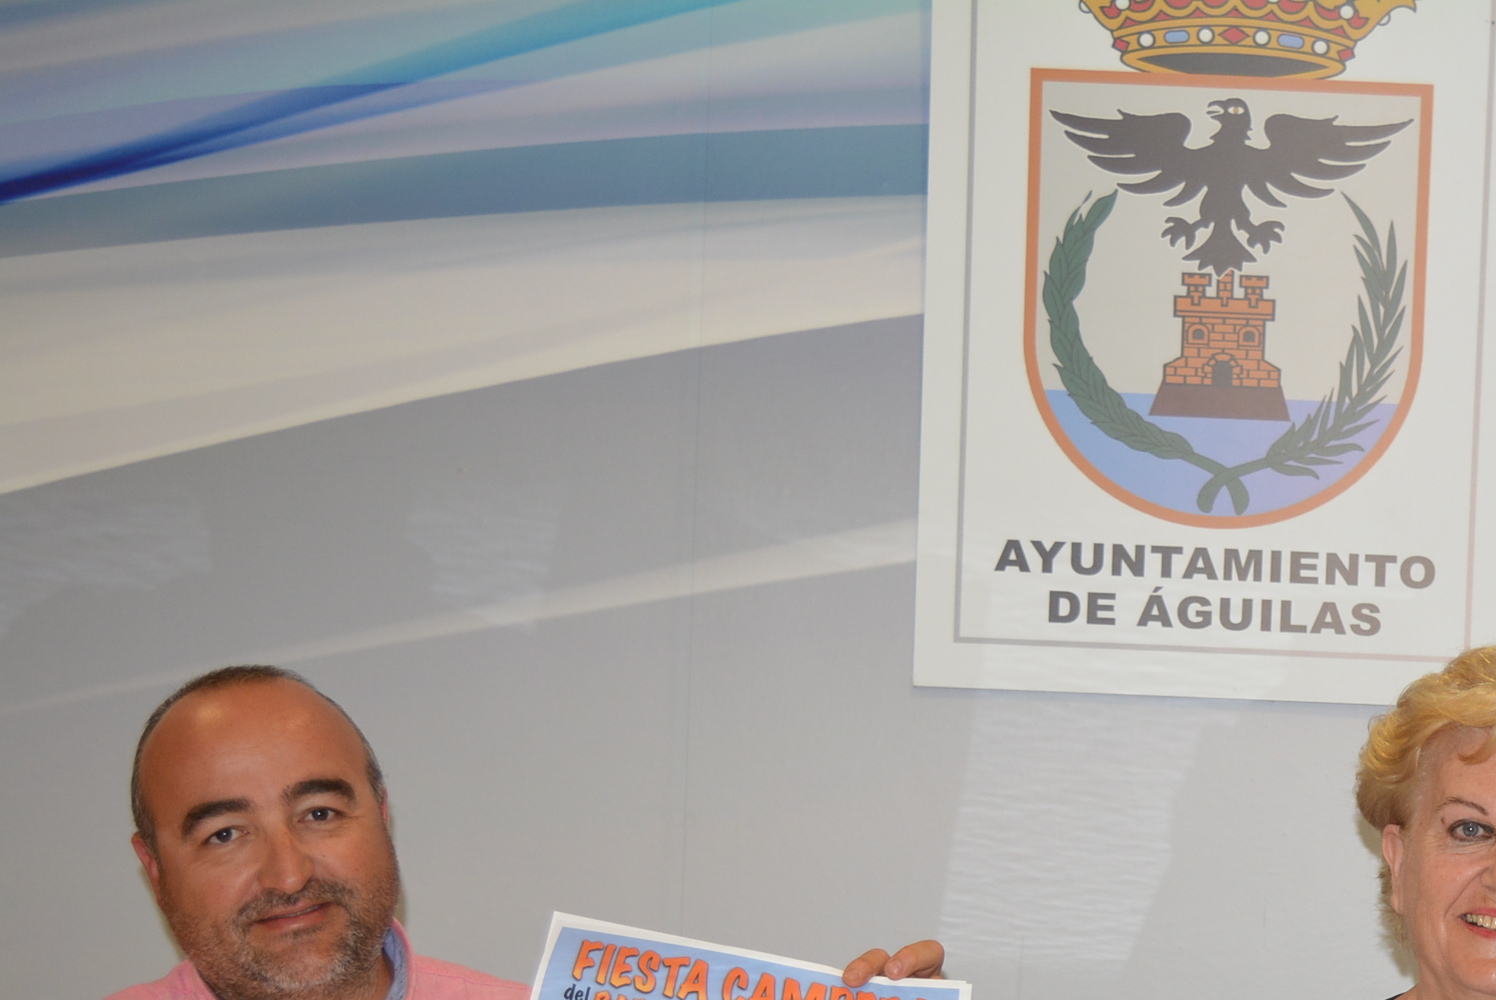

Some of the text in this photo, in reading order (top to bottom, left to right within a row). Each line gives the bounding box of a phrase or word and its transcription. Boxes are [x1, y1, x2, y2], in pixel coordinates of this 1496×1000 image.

[994, 538, 1436, 590] AYUNTAMIENTO
[1047, 586, 1382, 637] DE ÁGUILAS
